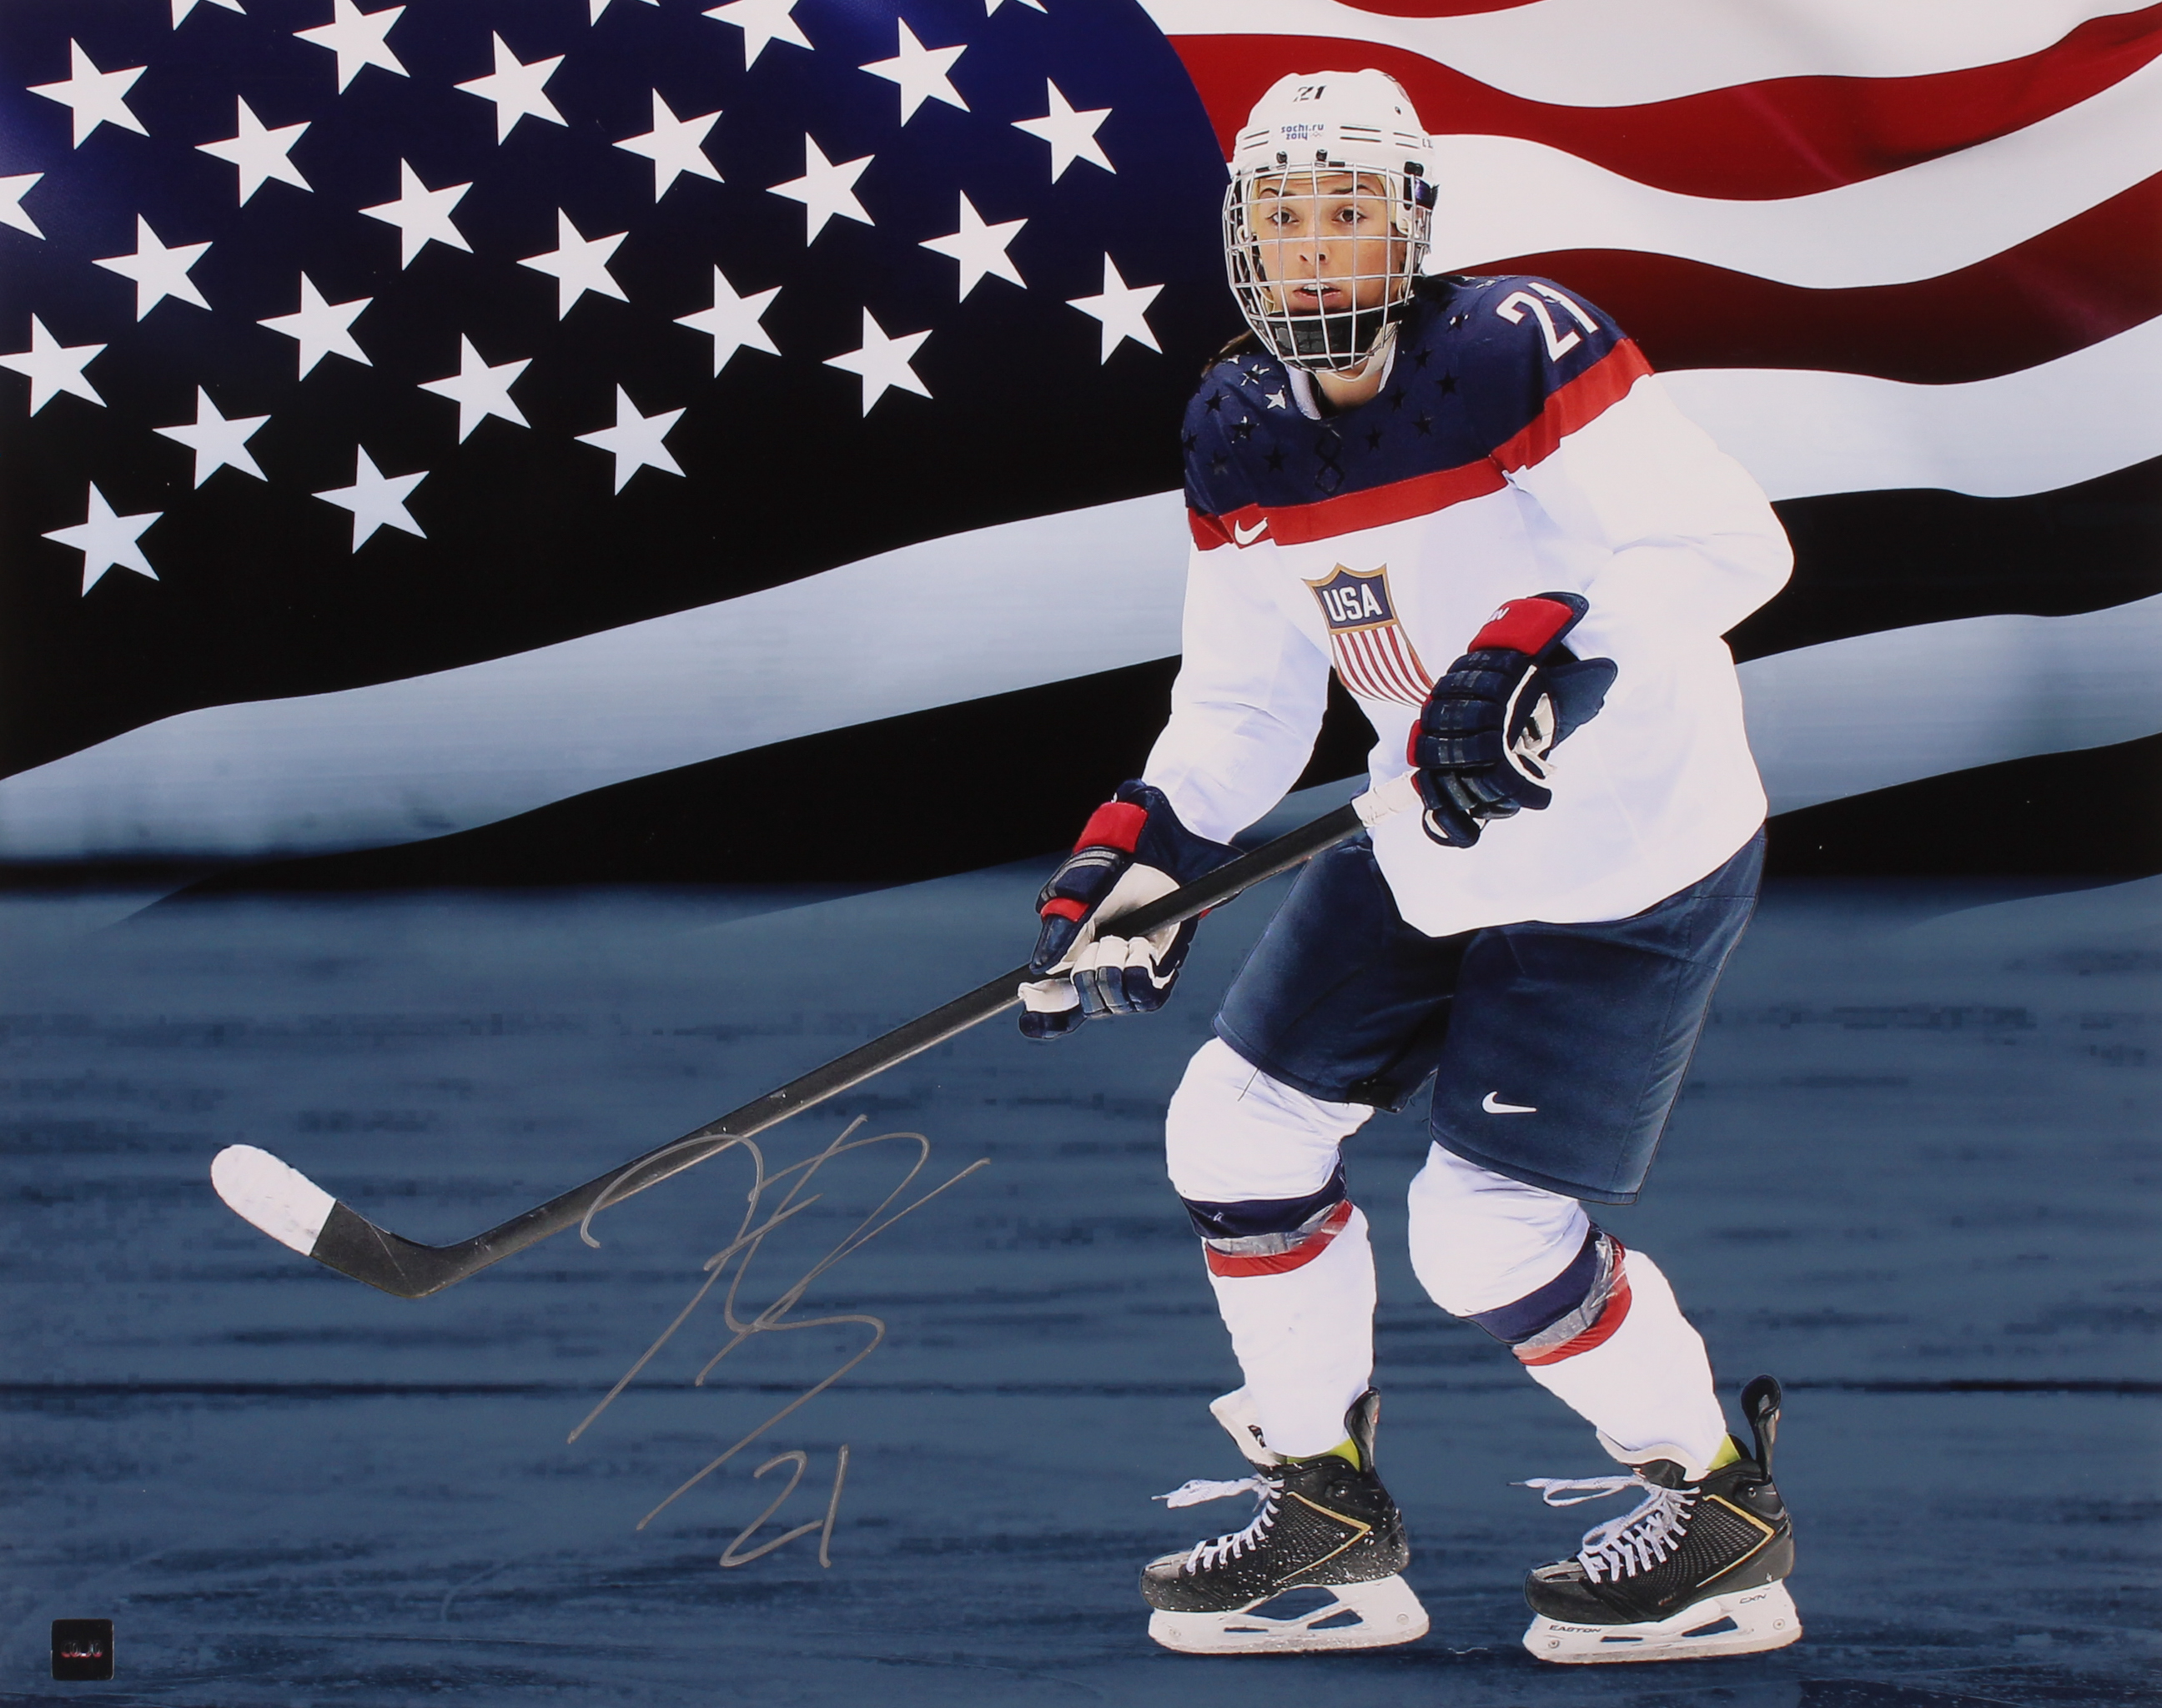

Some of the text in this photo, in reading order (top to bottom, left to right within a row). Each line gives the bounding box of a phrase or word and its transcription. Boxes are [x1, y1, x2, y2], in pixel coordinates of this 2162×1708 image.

[1293, 85, 1327, 103] 21
[1280, 123, 1325, 133] sochi.ru
[1285, 133, 1308, 141] 2014
[1496, 282, 1600, 363] 21
[1322, 583, 1383, 622] USA
[720, 1444, 849, 1568] 21
[1549, 1625, 1601, 1633] EASTON
